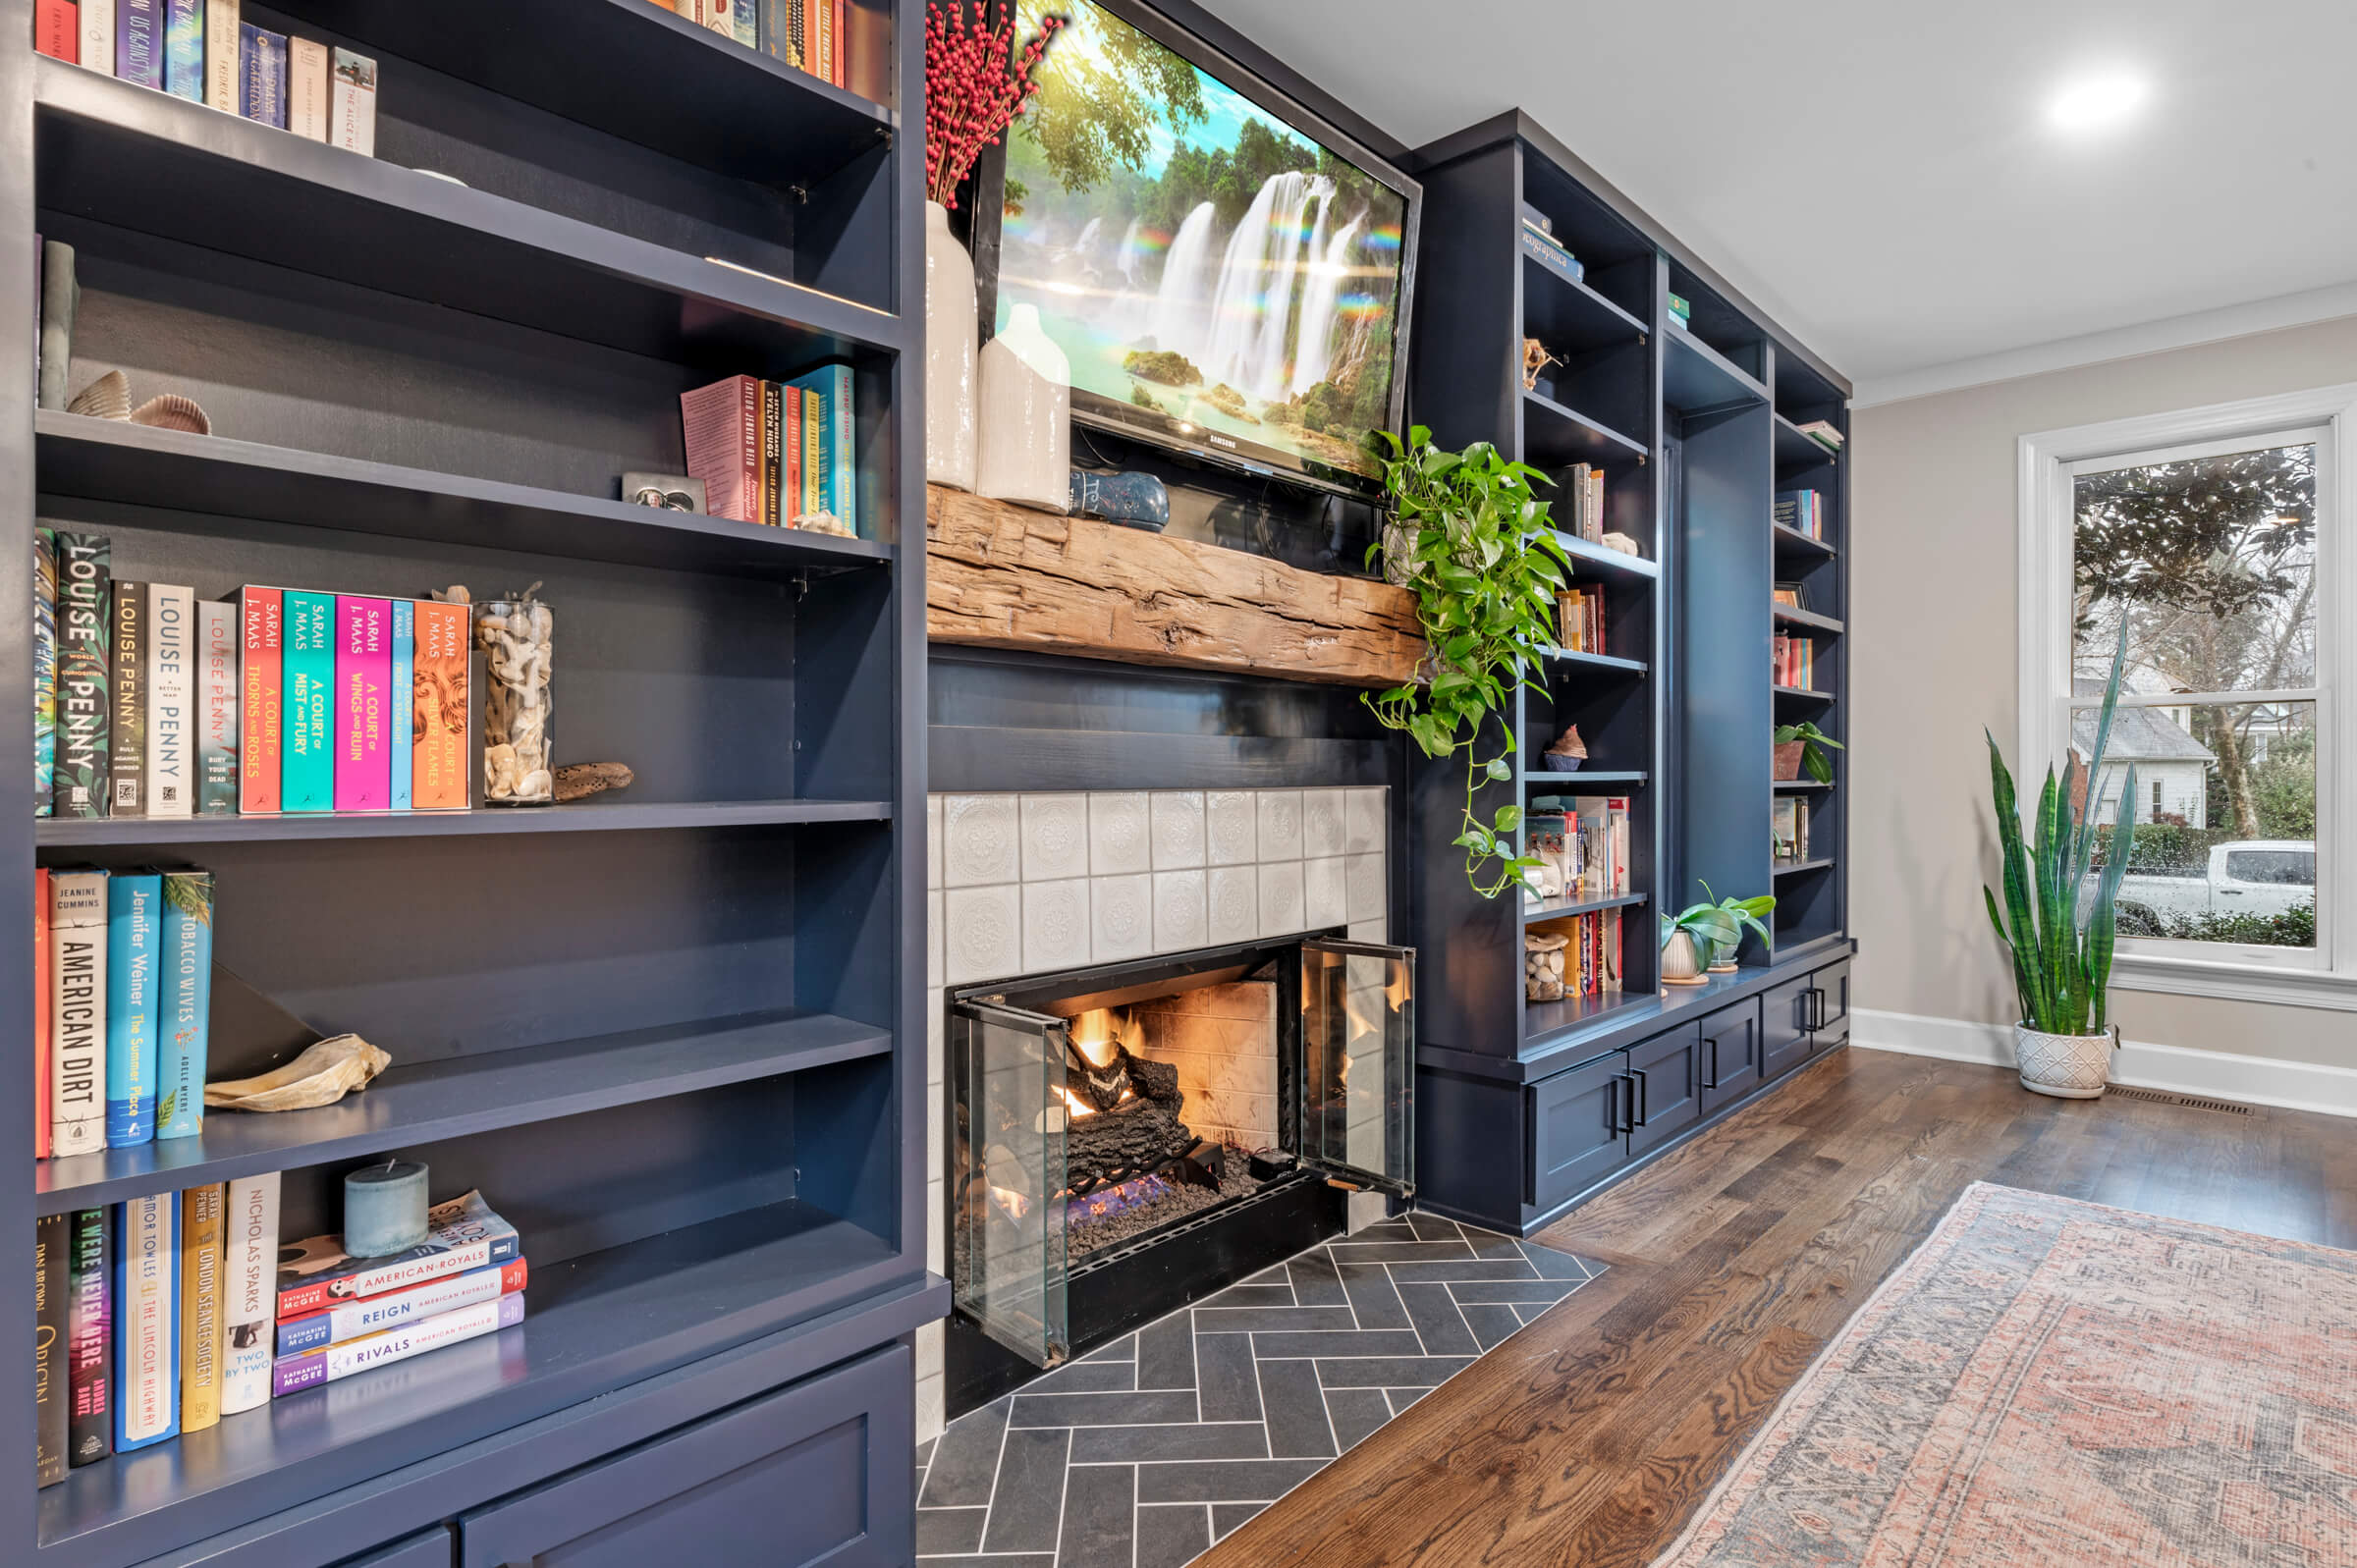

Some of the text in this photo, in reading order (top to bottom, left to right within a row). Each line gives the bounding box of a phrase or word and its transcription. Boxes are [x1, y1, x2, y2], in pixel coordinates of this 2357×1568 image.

[129, 16, 150, 85] US AGAINST YO
[219, 60, 229, 96] FREDRIK
[346, 108, 355, 134] ALICE
[1523, 233, 1567, 267] eographica
[744, 382, 755, 466] TAYLOR JENKINS REID
[69, 546, 97, 641] LOUISE
[160, 597, 181, 675] LOUISE
[247, 598, 260, 650] J. MAAS
[265, 604, 279, 648] SARAH
[295, 610, 307, 651] MAAS
[312, 605, 325, 649] SARAH
[351, 617, 363, 654] MAAS
[366, 610, 379, 652] SARAH
[429, 622, 440, 659] MAAS
[445, 616, 456, 657] SARAH
[120, 598, 137, 730] LOUISE PENNY
[211, 618, 225, 743] LOUISE PENNY
[311, 679, 323, 690] A
[247, 665, 260, 718] THORNS
[265, 687, 277, 697] A
[295, 673, 307, 704] MIST
[351, 673, 362, 713] WINGS
[366, 683, 377, 693] A
[67, 681, 96, 771] PENNY
[264, 702, 278, 746] COURT
[310, 694, 324, 738] COURT
[366, 697, 378, 739] COURT
[159, 706, 181, 778] PENNY
[247, 736, 259, 779] ROSES
[295, 722, 307, 756] FURY
[350, 731, 362, 762] RUIN
[427, 697, 440, 786] SILVER FLAMES
[444, 733, 456, 775] COURT
[57, 898, 100, 909] CUMMINS
[59, 887, 96, 897] JEANINE
[130, 891, 149, 1006] Jennifer Weiner
[178, 916, 196, 1023] TOBACCO WIVES
[62, 942, 93, 1051] AMERICAN
[130, 1013, 144, 1034] The
[62, 1057, 93, 1105] DIRT
[129, 1038, 143, 1083] Summer
[129, 1086, 143, 1117] Place
[179, 1055, 190, 1113] ADELE MYERS
[196, 1192, 207, 1223] PENNER
[208, 1191, 219, 1218] SARAH
[36, 1243, 46, 1266] DAN
[144, 1234, 157, 1278] TOWLES
[198, 1247, 215, 1293] LONDON
[246, 1189, 262, 1314] NICHOLAS SPARKS
[363, 1263, 435, 1289] AMERICAN
[440, 1250, 486, 1270] ROYALS
[81, 1223, 102, 1369] WERE NEVER HERE
[284, 1289, 320, 1303] KATHARINE
[284, 1294, 320, 1310] McGEE
[362, 1303, 411, 1325] REIGN
[418, 1292, 459, 1307] AMERICAN
[288, 1325, 327, 1339] KATHARINE
[288, 1330, 327, 1347] McGEE
[356, 1338, 410, 1364] RIVALS
[143, 1300, 157, 1428] THE LINCOLN HIGHWAY
[196, 1338, 212, 1388] SOCIETY
[225, 1359, 271, 1378] BY TWO
[236, 1350, 266, 1364] TWO
[283, 1363, 323, 1379] KATHARINE
[284, 1369, 323, 1386] McGEE
[78, 1385, 90, 1416] BARTZ
[92, 1378, 105, 1415] ANDREA
